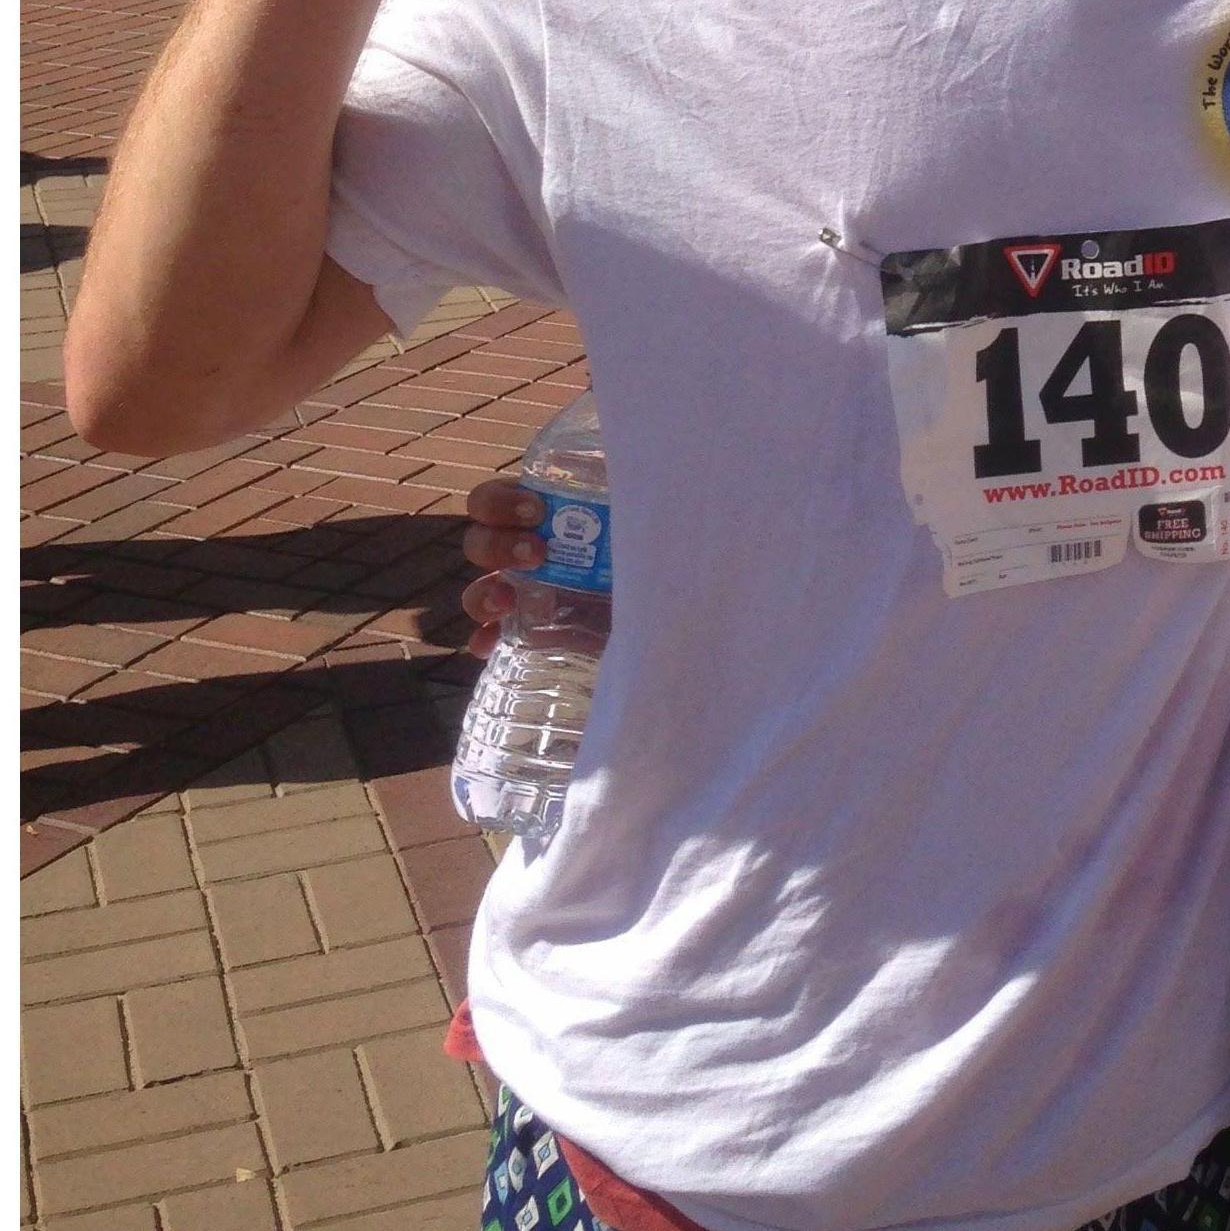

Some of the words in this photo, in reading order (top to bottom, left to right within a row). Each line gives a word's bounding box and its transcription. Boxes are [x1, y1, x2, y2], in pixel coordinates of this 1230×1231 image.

[1202, 76, 1219, 111] The
[1103, 282, 1128, 295] Who
[1133, 280, 1142, 292] I
[983, 463, 1227, 504] www.RoadID.com
[1156, 518, 1190, 529] FREE
[1143, 528, 1202, 540] SHIPPING
